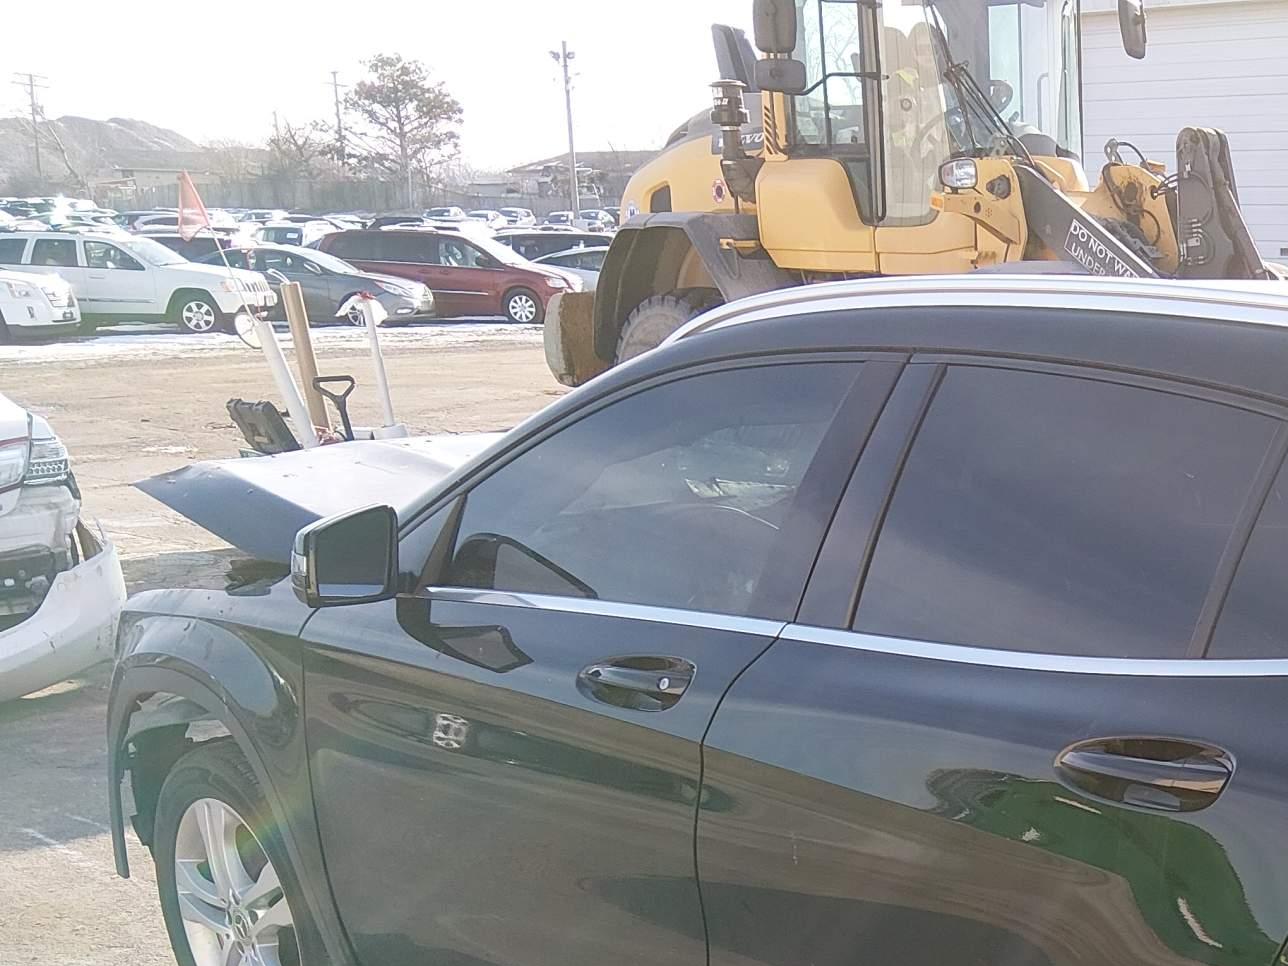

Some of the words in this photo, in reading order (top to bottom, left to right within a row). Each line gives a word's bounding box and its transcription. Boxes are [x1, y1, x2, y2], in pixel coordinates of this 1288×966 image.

[1071, 222, 1087, 242] DO
[1088, 238, 1113, 264] NOT
[1114, 259, 1138, 278] WA
